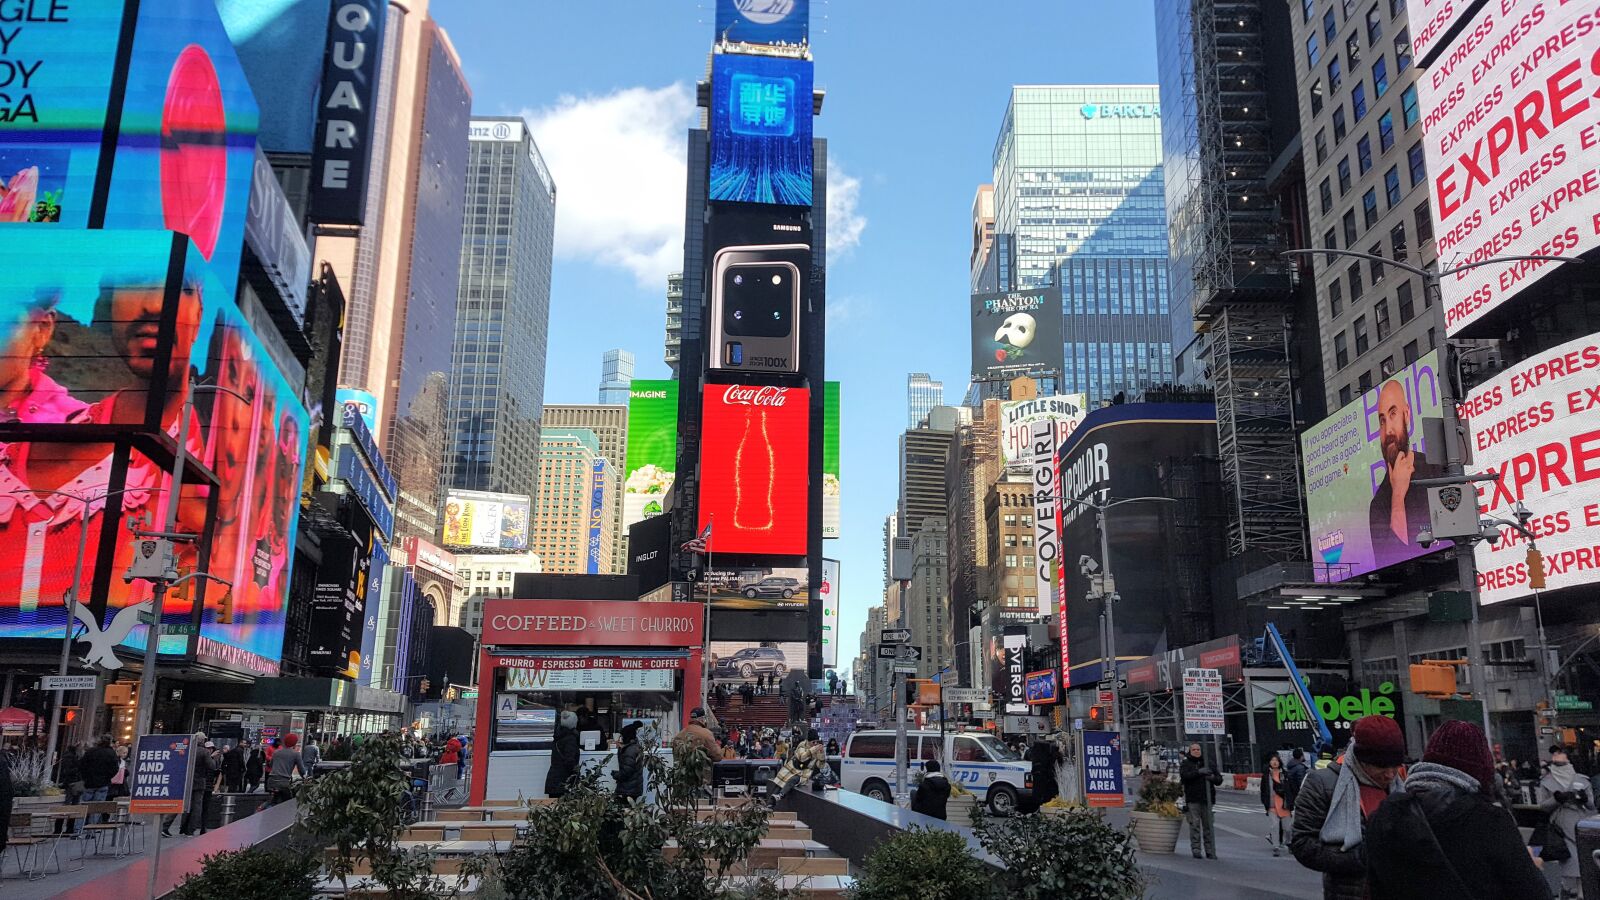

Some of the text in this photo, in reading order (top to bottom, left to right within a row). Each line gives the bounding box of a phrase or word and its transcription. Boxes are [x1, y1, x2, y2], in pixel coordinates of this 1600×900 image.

[1432, 14, 1495, 91] EXPRESS
[1472, 3, 1546, 86] EXPRESS
[1440, 5, 1600, 156] EXPRESS EXPRES
[1100, 105, 1160, 118] BARCLA
[1435, 48, 1600, 222] EXPRE
[1489, 144, 1567, 216] EXPRESS
[773, 224, 802, 232] SAMSUNG
[1455, 170, 1600, 281] EXPRESS EXPRE
[1500, 226, 1579, 292] EXPRESS
[985, 295, 1044, 309] PHANTOM
[764, 357, 788, 368] 100X
[629, 391, 667, 399] IMAGINE
[723, 384, 788, 407] Coca-Cola
[1009, 400, 1079, 423] LITTLE SHOP
[1309, 434, 1320, 449] you
[1320, 414, 1353, 441] appreciate
[1352, 411, 1358, 420] a
[1476, 401, 1555, 452] EXPRESS
[1009, 420, 1077, 459] HORS
[1306, 447, 1321, 467] good
[1321, 436, 1339, 455] beard
[1307, 467, 1315, 478] as
[1314, 456, 1332, 473] much
[1332, 454, 1339, 467] as
[1344, 438, 1362, 461] good
[1309, 476, 1324, 495] good
[590, 468, 606, 529] NOVOTEL
[1034, 422, 1057, 583] COVERGIRL
[462, 502, 471, 517] KING
[1063, 506, 1078, 529] THAT
[460, 517, 469, 532] LION
[1317, 529, 1344, 551] twitch
[635, 550, 659, 562] INGLOT
[492, 615, 588, 632] COFFEED
[598, 616, 637, 633] SWEET
[640, 616, 695, 633] CHURROS
[1000, 611, 1041, 619] MOTHERLA
[885, 632, 908, 640] ONE WAY
[1061, 610, 1071, 684] CHOCOLATE
[500, 658, 680, 669] CHURRO ESPRESSO BEER WINE COFFEE
[501, 698, 512, 711] A
[1314, 682, 1396, 721] pelé
[1284, 721, 1309, 730] SOCCER
[140, 751, 171, 761] BEER
[1087, 745, 1112, 755] BEER
[139, 763, 165, 773] AND
[1088, 757, 1109, 767] AND
[138, 774, 170, 785] WINE
[1088, 769, 1114, 779] WINE
[135, 786, 170, 798] AREA
[1089, 781, 1116, 791] AREA
